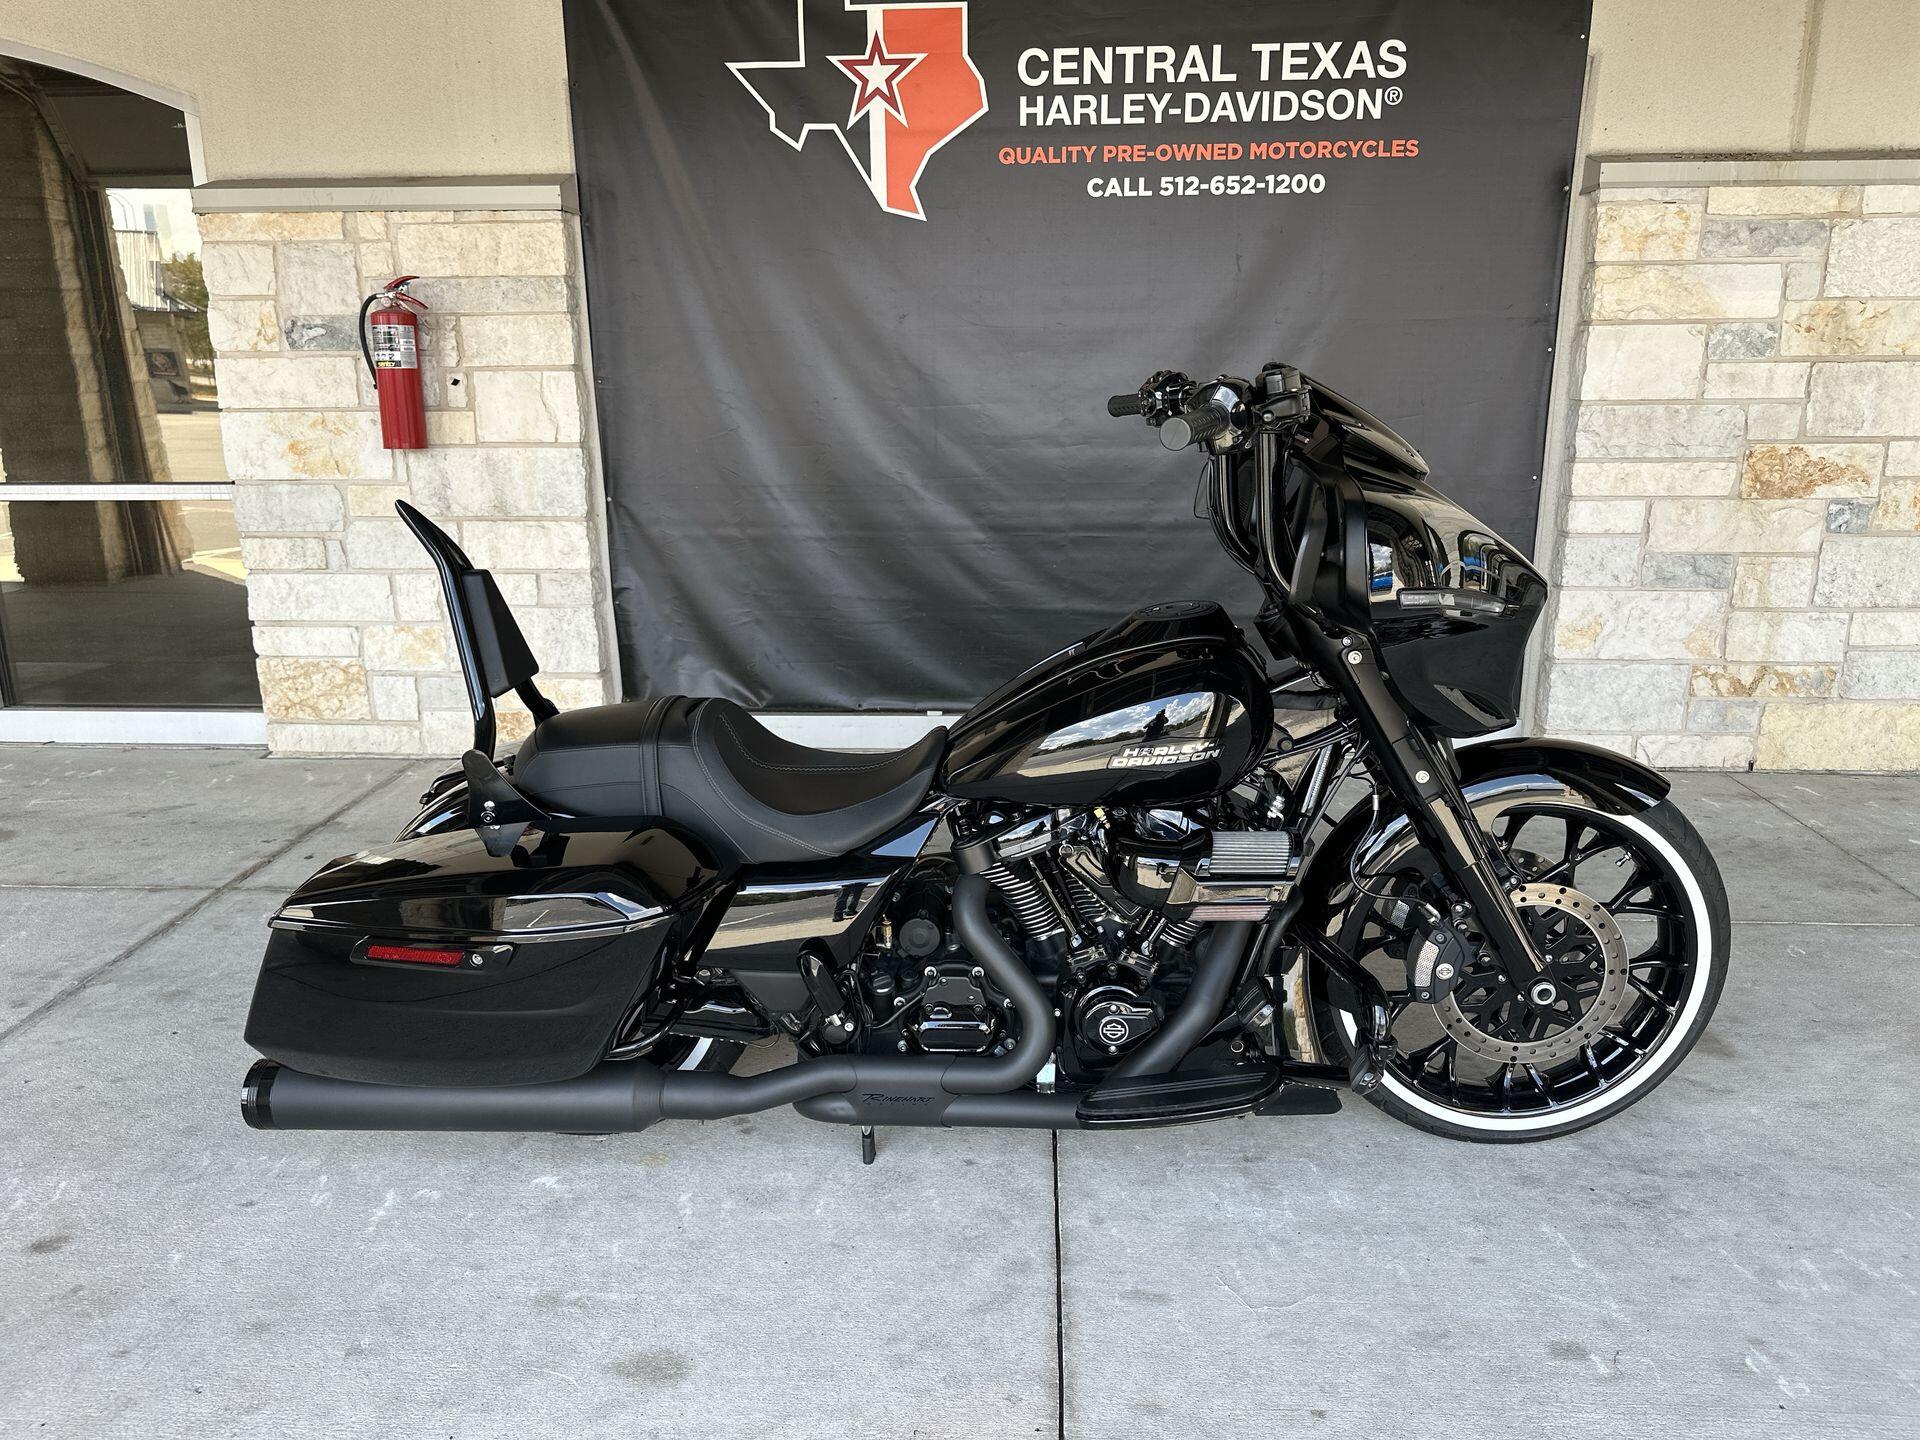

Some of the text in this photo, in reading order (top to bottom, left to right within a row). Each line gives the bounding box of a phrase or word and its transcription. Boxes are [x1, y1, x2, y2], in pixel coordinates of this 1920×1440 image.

[1018, 39, 1406, 86] CENTRAL TEXAS
[999, 140, 1418, 164] QUALITY PRE-OWNED MOTORCYCLES
[1087, 174, 1325, 197] CALL 512-652-1200
[1112, 749, 1219, 767] DAVIDSON
